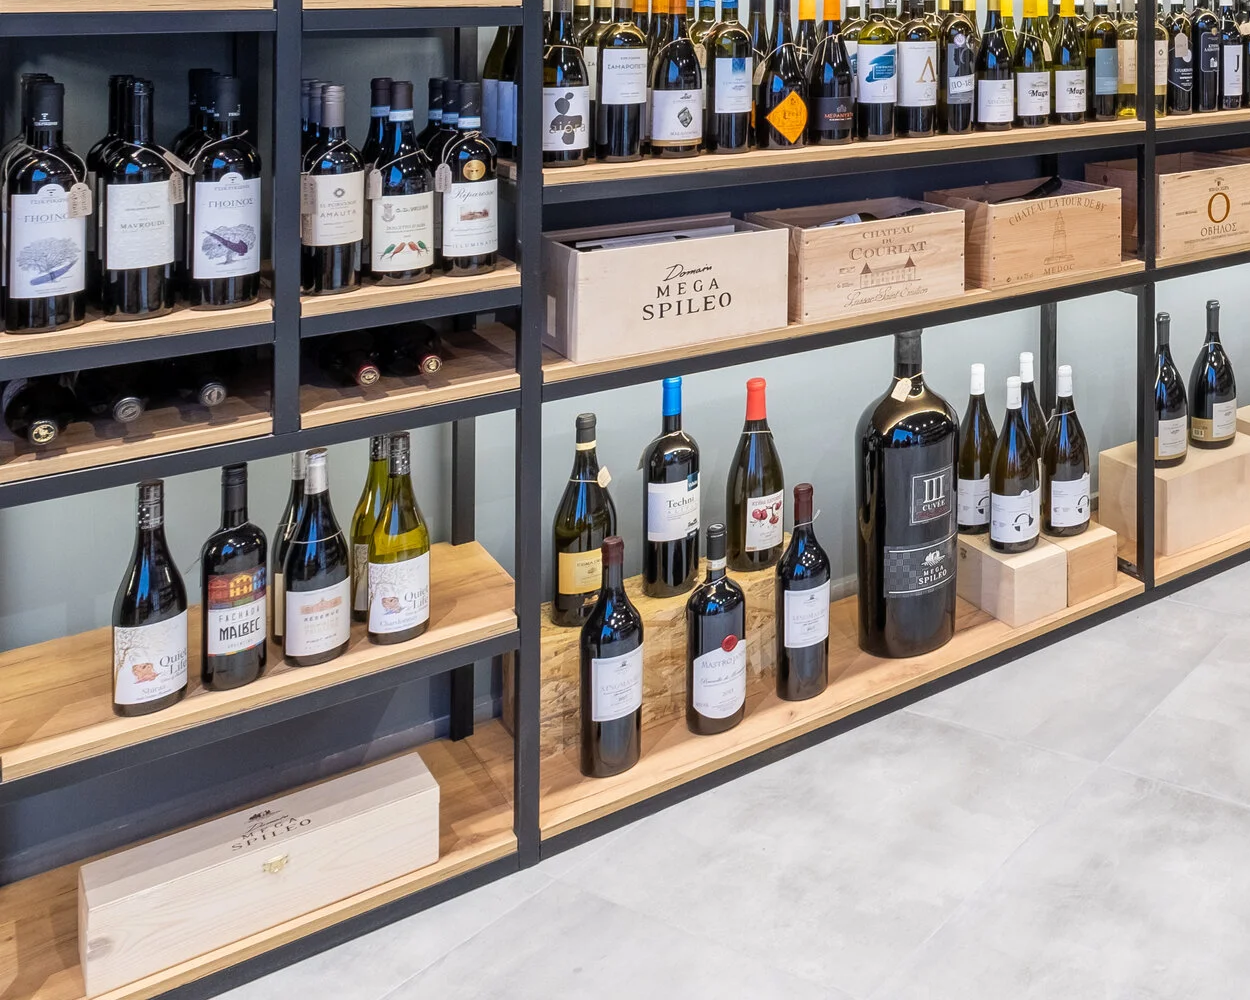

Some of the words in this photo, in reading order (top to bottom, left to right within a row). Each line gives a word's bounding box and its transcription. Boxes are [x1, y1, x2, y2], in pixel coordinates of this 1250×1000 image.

[319, 210, 358, 218] AMAUTA
[1008, 202, 1046, 226] CHATEAU
[1048, 200, 1060, 208] LA
[1060, 197, 1083, 206] TOUR
[1083, 198, 1094, 208] DE
[120, 220, 165, 229] MAVROUDI
[862, 225, 915, 239] CHATEAU
[656, 277, 719, 299] MEGA
[642, 291, 732, 321] SPILEO
[918, 569, 948, 585] SPILEO
[923, 564, 944, 577] MEGA
[218, 616, 261, 642] MALBEC
